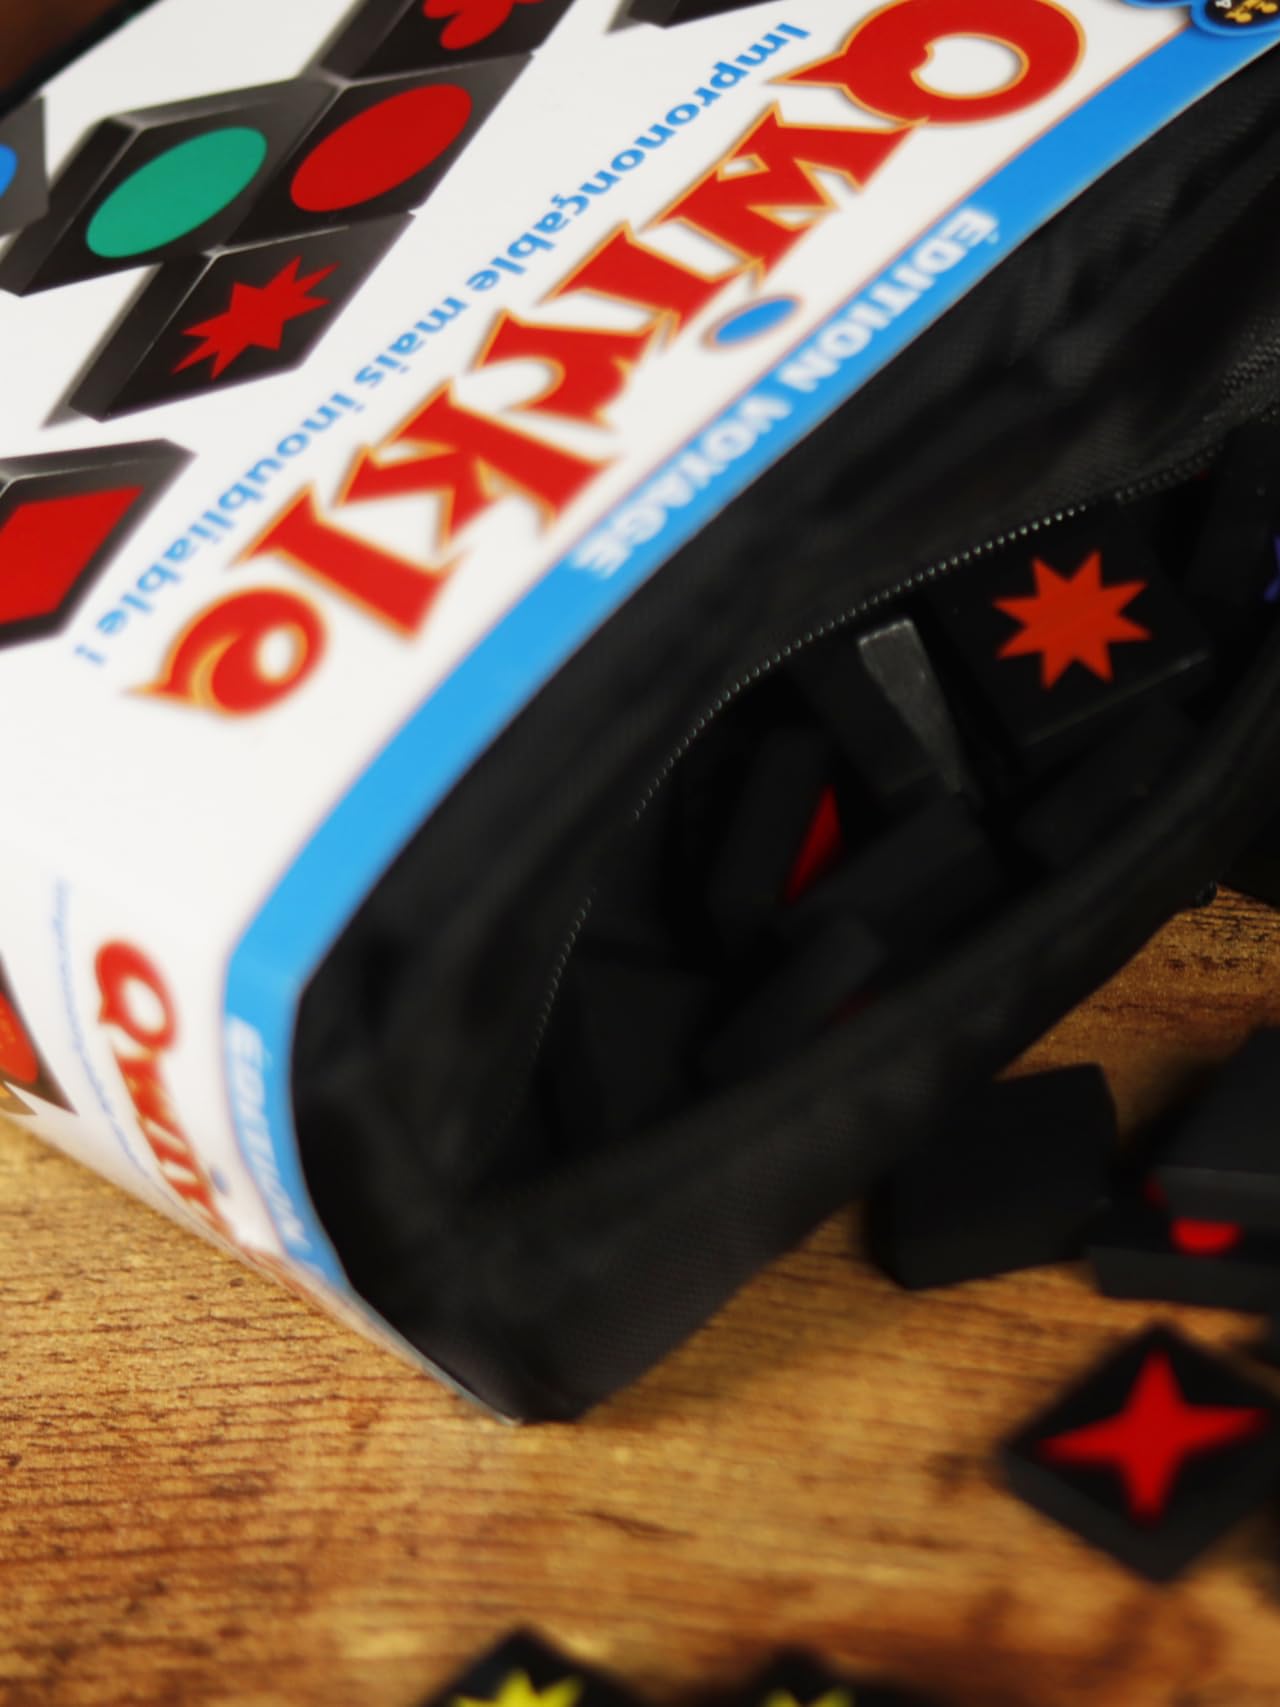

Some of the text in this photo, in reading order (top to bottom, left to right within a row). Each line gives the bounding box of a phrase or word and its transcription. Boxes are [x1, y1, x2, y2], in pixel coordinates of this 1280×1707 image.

[465, 22, 812, 292] Imprononçable
[123, 0, 1086, 718] Qwirkle
[354, 296, 468, 388] mais
[571, 207, 1000, 579] ÉDITION VOYAGE
[96, 391, 365, 634] inoubliable
